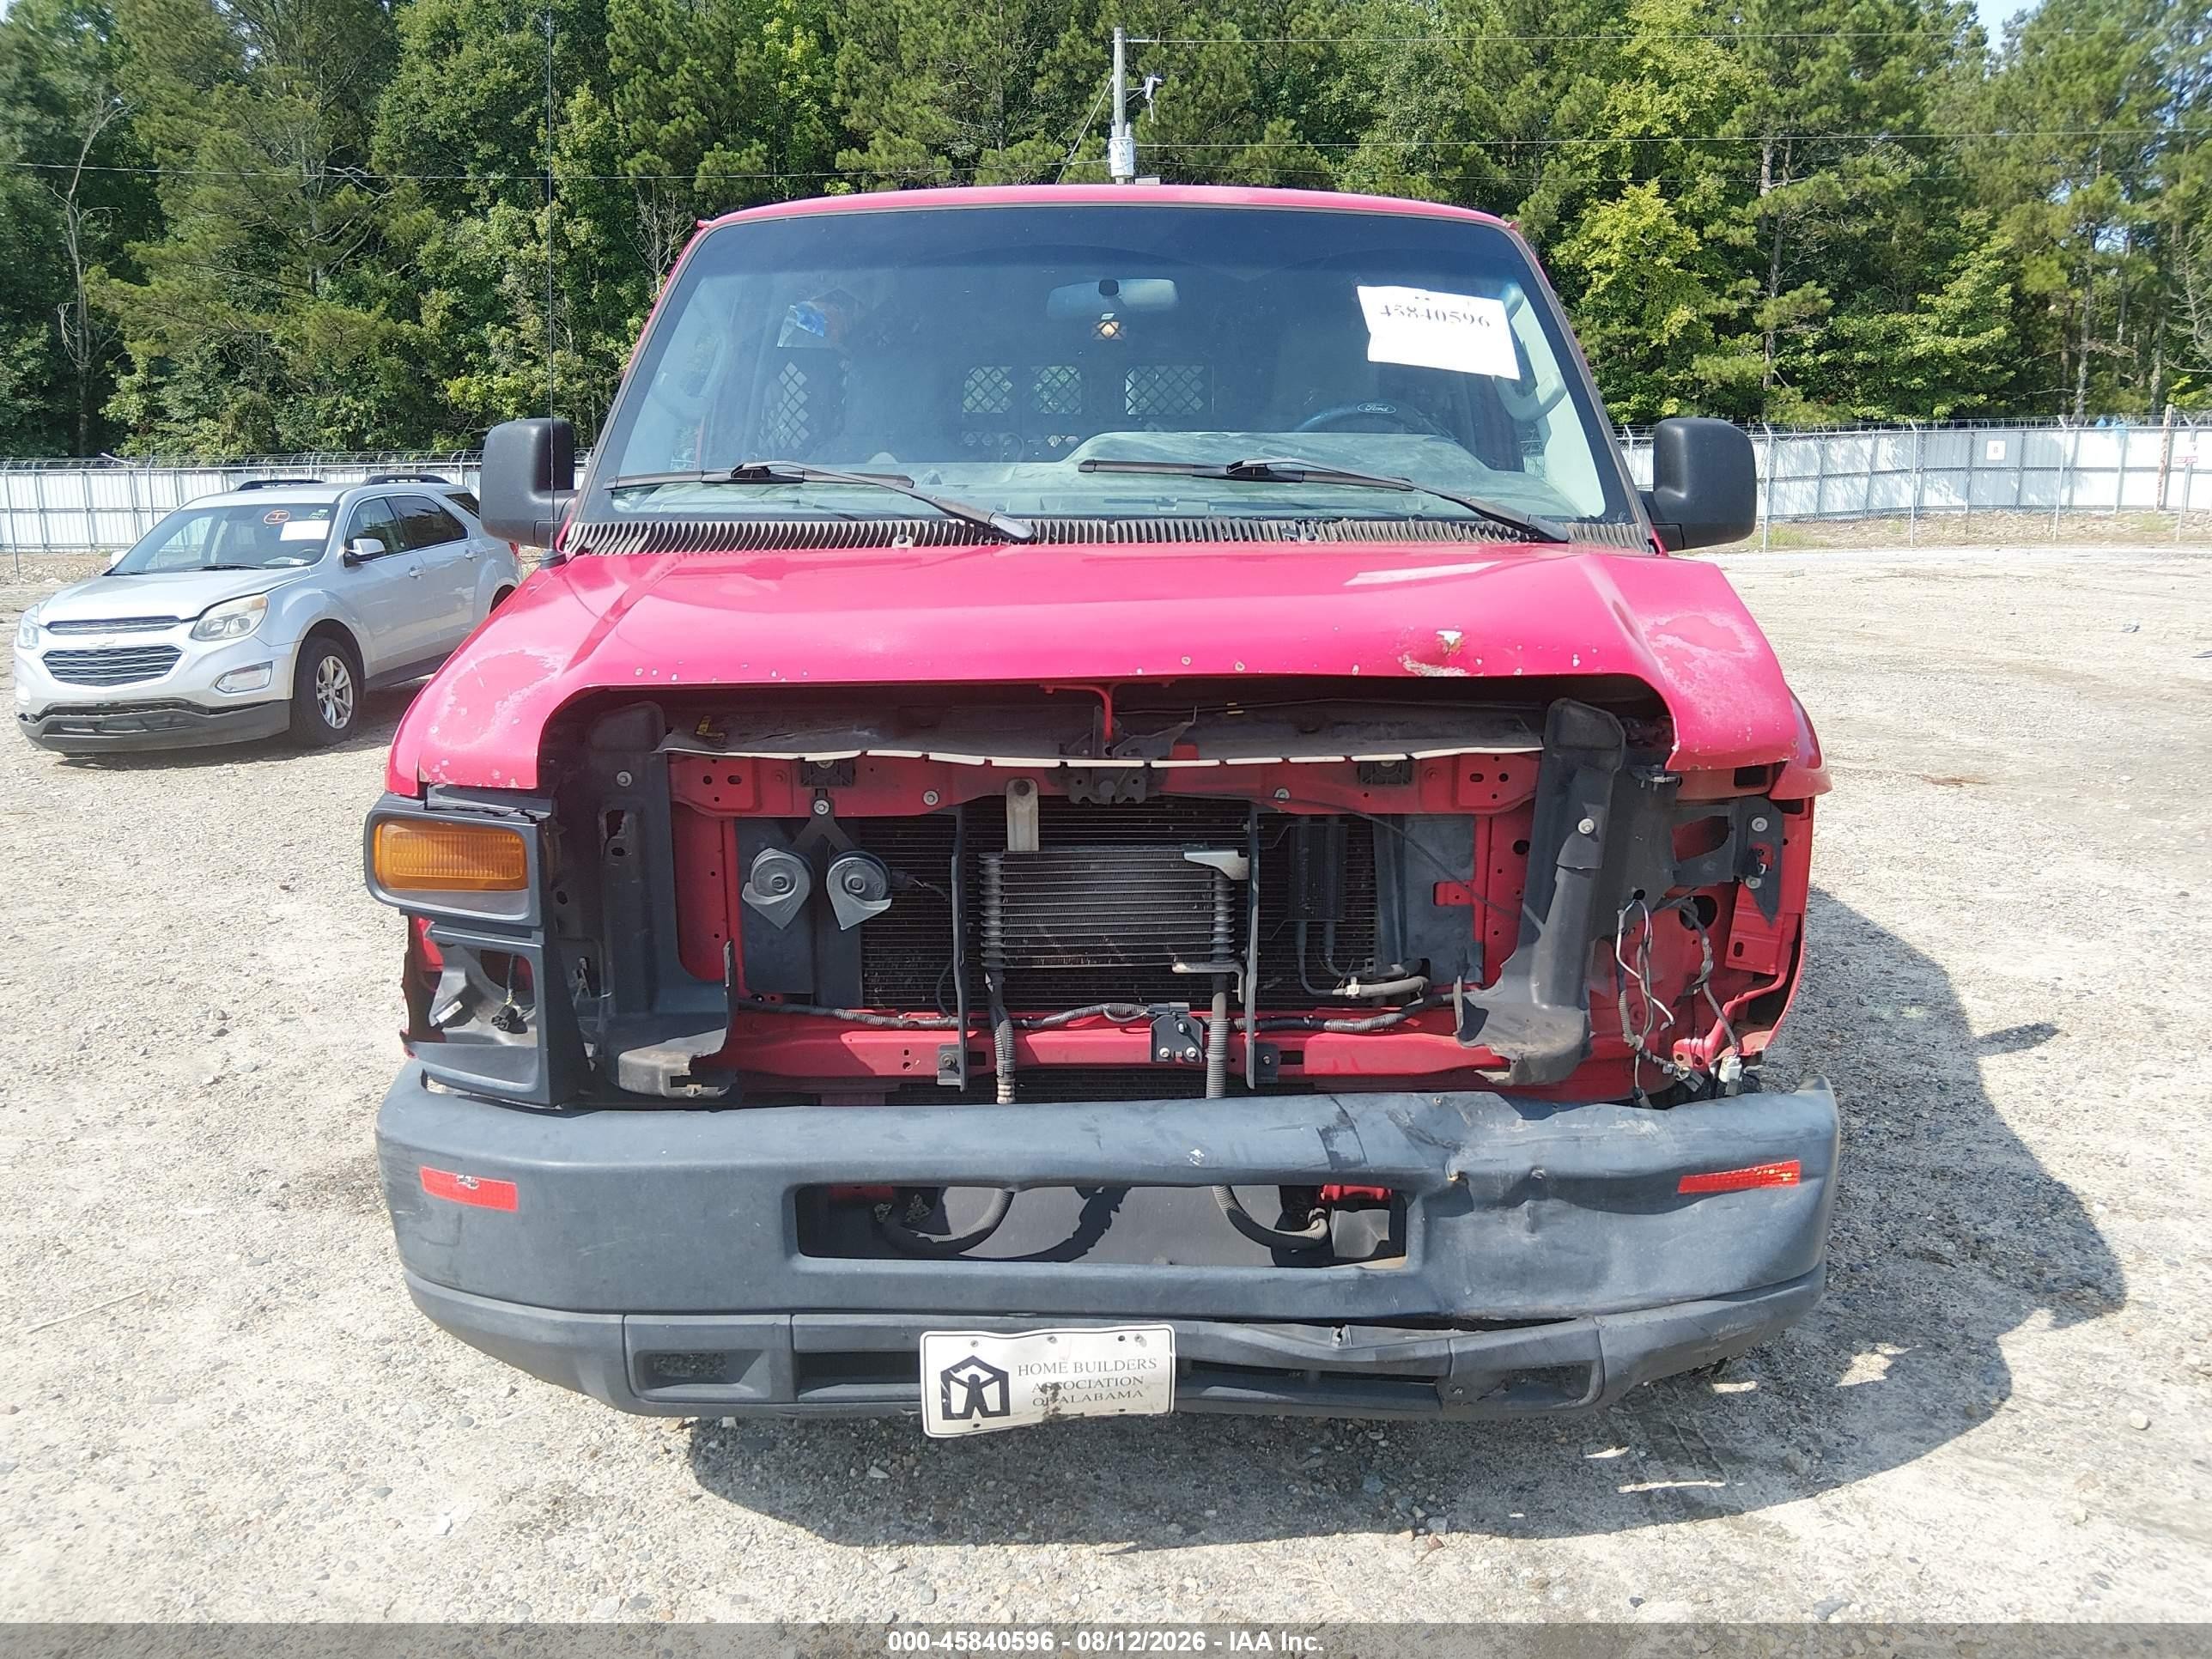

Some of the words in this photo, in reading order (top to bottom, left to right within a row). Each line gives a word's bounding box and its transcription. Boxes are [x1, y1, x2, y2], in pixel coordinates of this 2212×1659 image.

[1018, 1361, 1068, 1376] HOME
[1073, 1358, 1157, 1374] BUILDERS
[1059, 1389, 1144, 1404] ALABAMA
